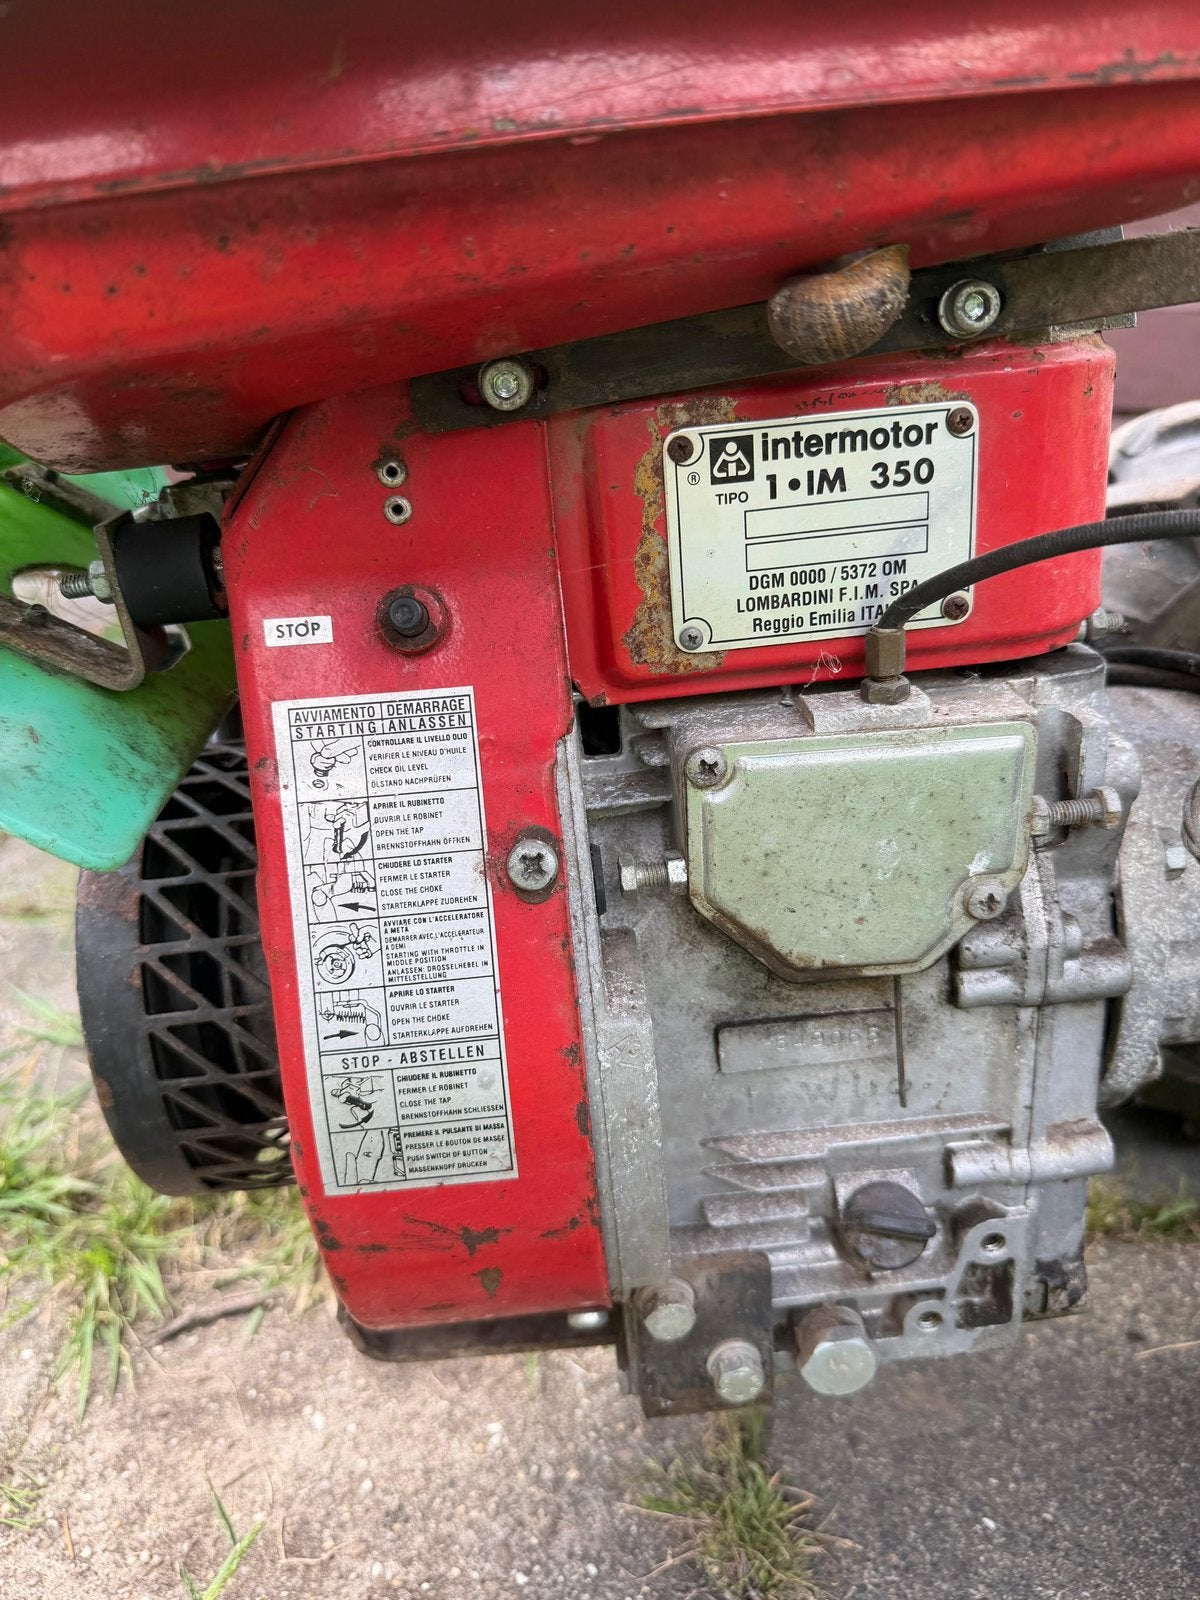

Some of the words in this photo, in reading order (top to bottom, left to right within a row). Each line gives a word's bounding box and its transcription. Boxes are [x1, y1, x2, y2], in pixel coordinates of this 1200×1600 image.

[761, 421, 938, 462] intermotor
[715, 491, 749, 505] TIPO
[870, 458, 934, 490] 350
[749, 575, 785, 590] DGM
[790, 568, 826, 586] 0000
[830, 568, 837, 584] /
[841, 563, 876, 580] 5372
[883, 559, 907, 577] OM
[736, 591, 834, 613] LOMBARDINI
[840, 584, 883, 600] F.I.M.
[752, 616, 804, 634] Reggio
[809, 607, 855, 627] Emilia
[276, 622, 320, 639] STOP
[387, 698, 465, 716] DEMARRAGE
[294, 706, 375, 723] AVVIAMENTO
[389, 714, 466, 731] ANLASSEN
[296, 722, 376, 739] STARTING
[368, 737, 414, 747] CONTROLLARE
[424, 734, 450, 742] LIVELLO
[412, 749, 437, 757] NIVEAU
[408, 797, 444, 807] RUBINETTO
[374, 816, 400, 824] OUVRIR
[413, 811, 443, 820] ROBINET
[376, 829, 393, 837] OPEN
[377, 839, 441, 850] BRENNSTOFFHAHN
[378, 860, 411, 869] CHIUDERE
[423, 857, 452, 865] STARTER
[380, 874, 407, 883] FERMER
[410, 872, 417, 880] LE
[420, 870, 450, 879] STARTER
[381, 888, 402, 897] CLOSE
[420, 885, 443, 893] CHOKE
[382, 900, 438, 910] STARTERKLAPPE
[441, 895, 478, 905] ZUDREHEN
[384, 918, 411, 927] AVVIARE
[429, 912, 484, 923] L'ACCELERATORE
[385, 935, 417, 943] DEMARRER
[386, 951, 418, 959] STARTING
[441, 946, 475, 954] THROTTLE
[415, 955, 446, 964] POSITION
[427, 962, 479, 972] DROSSELHEBEL
[388, 972, 447, 983] MITTELSTELLUNG
[390, 990, 413, 998] APRIRE
[426, 986, 455, 994] STARTER
[391, 1003, 417, 1012] OUVRIR
[430, 999, 460, 1007] STARTER
[427, 1014, 450, 1022] CHOKE
[393, 1028, 449, 1039] STARTERKLAPPE
[451, 1024, 493, 1033] AUFDREHEN
[342, 1056, 380, 1069] STOP
[400, 1045, 484, 1064] ABSTELLEN
[397, 1072, 429, 1082] CHIUDERE
[440, 1068, 476, 1077] RUBINETTO
[399, 1086, 426, 1095] FERMER
[439, 1082, 468, 1091] ROBINET
[400, 1100, 421, 1108] CLOSE
[401, 1109, 462, 1120] BRENNSTOFFHAHN
[464, 1104, 503, 1113] SCHLIESSEN
[404, 1130, 433, 1138] PREMERE
[442, 1126, 473, 1134] PULSANTE
[405, 1142, 434, 1150] PRESSER
[446, 1138, 471, 1146] BOUTON
[407, 1153, 424, 1161] PUSH
[426, 1150, 450, 1160] SWITCH
[409, 1163, 454, 1173] MASSENKNOPF
